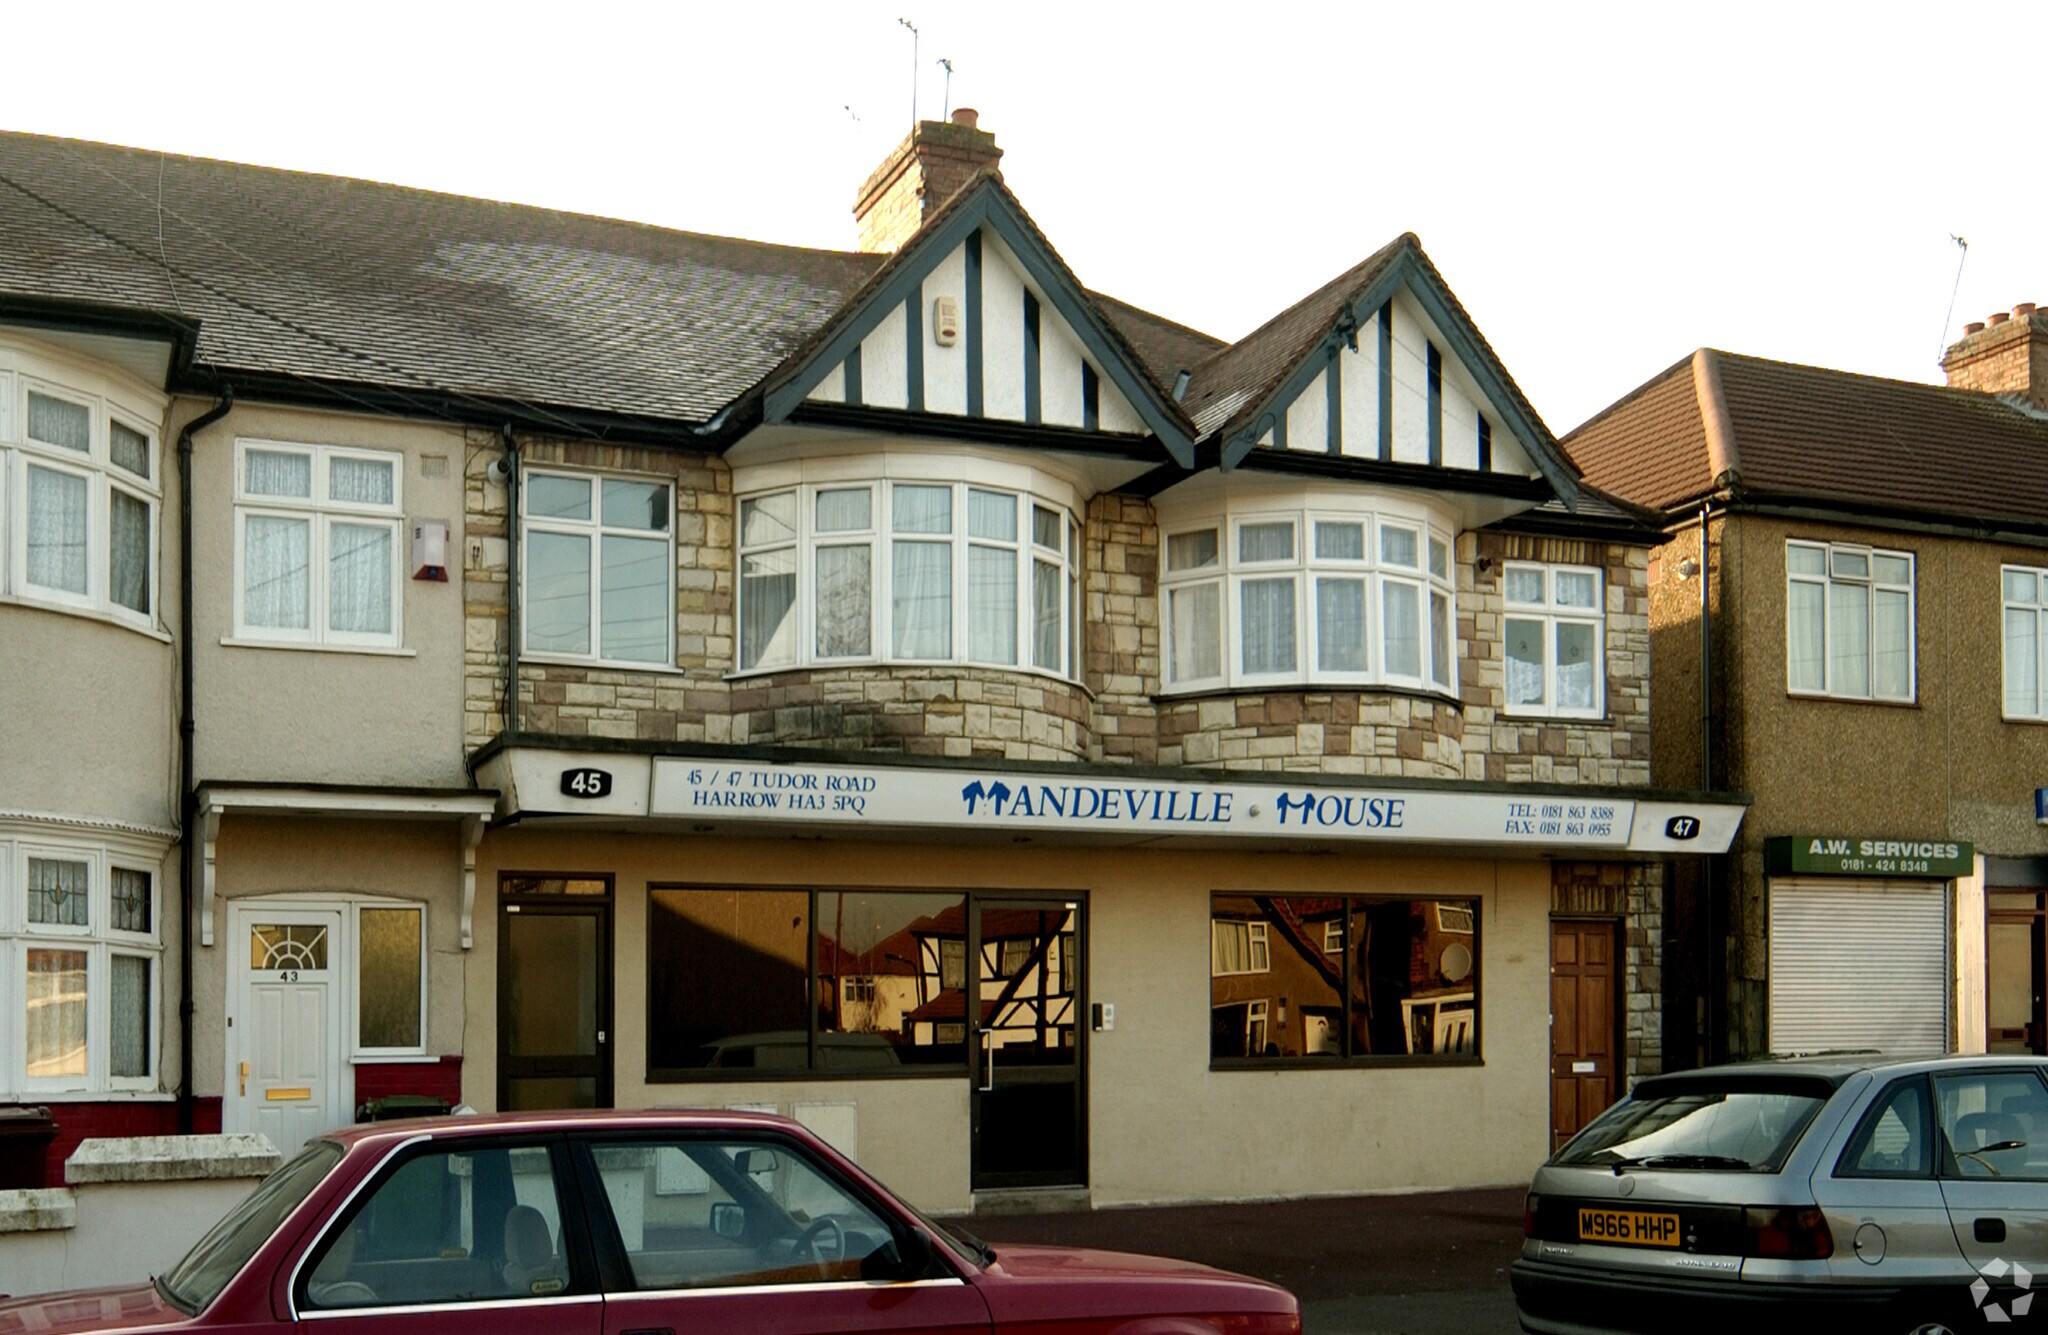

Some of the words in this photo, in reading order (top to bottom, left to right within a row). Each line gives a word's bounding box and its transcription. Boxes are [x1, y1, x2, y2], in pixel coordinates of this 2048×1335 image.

[571, 772, 601, 794] 45
[687, 769, 702, 785] 45
[726, 771, 742, 786] 47
[750, 771, 818, 790] TUDOR
[826, 775, 876, 792] ROAD
[693, 790, 781, 808] HARROW
[788, 794, 825, 810] HA3
[833, 795, 866, 816] 5PQ
[962, 780, 1233, 822] MANDEVILLE
[1277, 792, 1405, 828] HOUSE
[1508, 804, 1537, 818] TEL:
[1541, 805, 1563, 818] 0181
[1568, 805, 1586, 819] 863
[1505, 820, 1535, 834] FAX:
[1539, 821, 1561, 835] 0181
[1565, 822, 1584, 836] 863
[1588, 822, 1612, 836] 0955
[1673, 818, 1693, 837] 47
[1809, 839, 1851, 855] A.W.
[1860, 841, 1959, 859] SERVICES
[1841, 859, 1865, 871] 0181
[1875, 860, 1896, 872] 424
[280, 970, 299, 982] 43
[1581, 1213, 1631, 1238] M966
[1635, 1216, 1677, 1241] HHP
